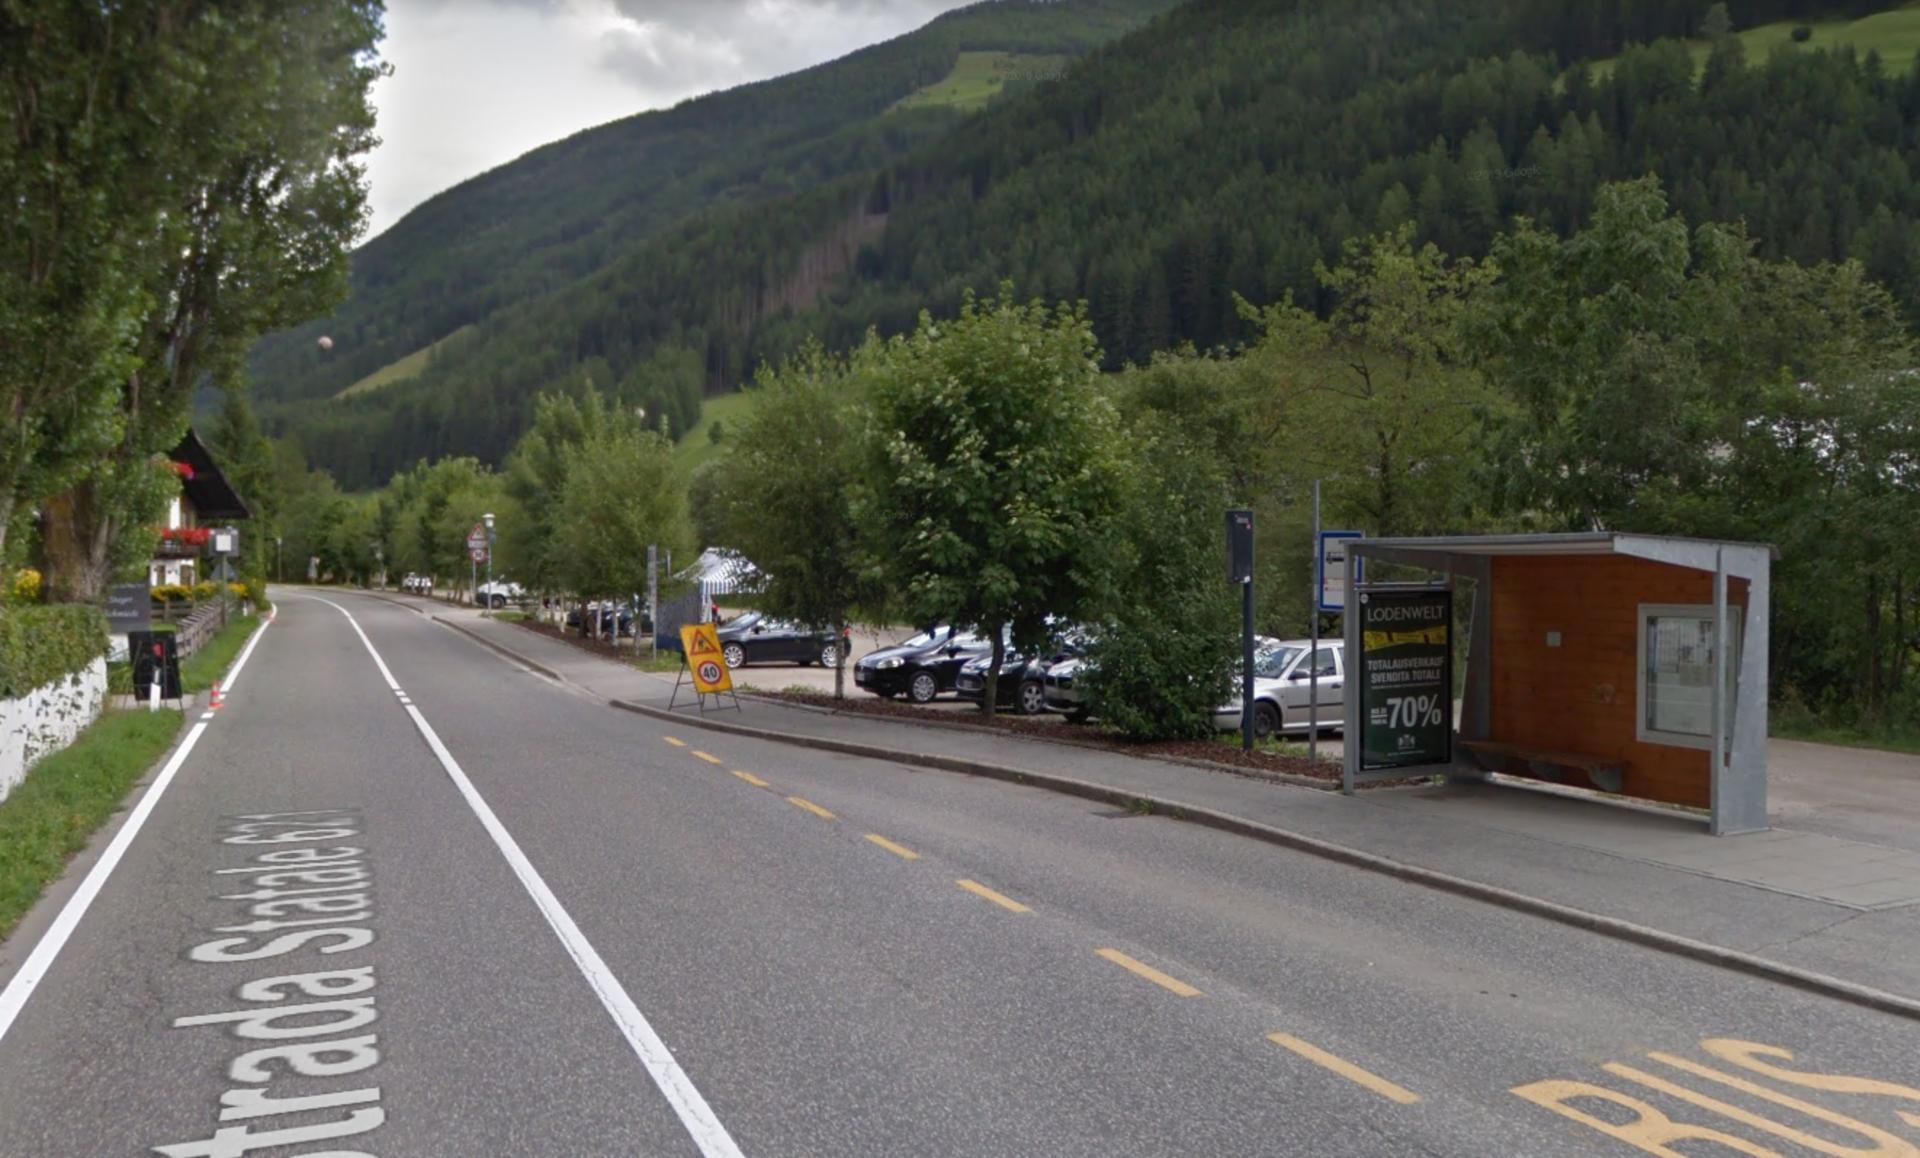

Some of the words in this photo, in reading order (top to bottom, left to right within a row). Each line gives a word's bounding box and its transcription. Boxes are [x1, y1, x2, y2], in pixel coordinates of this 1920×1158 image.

[1367, 605, 1444, 621] LODENWELT
[1368, 656, 1444, 670] TOTALAUSVERKAUF
[703, 666, 717, 679] 40
[1371, 671, 1410, 684] SVENDITA
[1412, 668, 1441, 681] TOTALE
[1386, 694, 1442, 729] 70%
